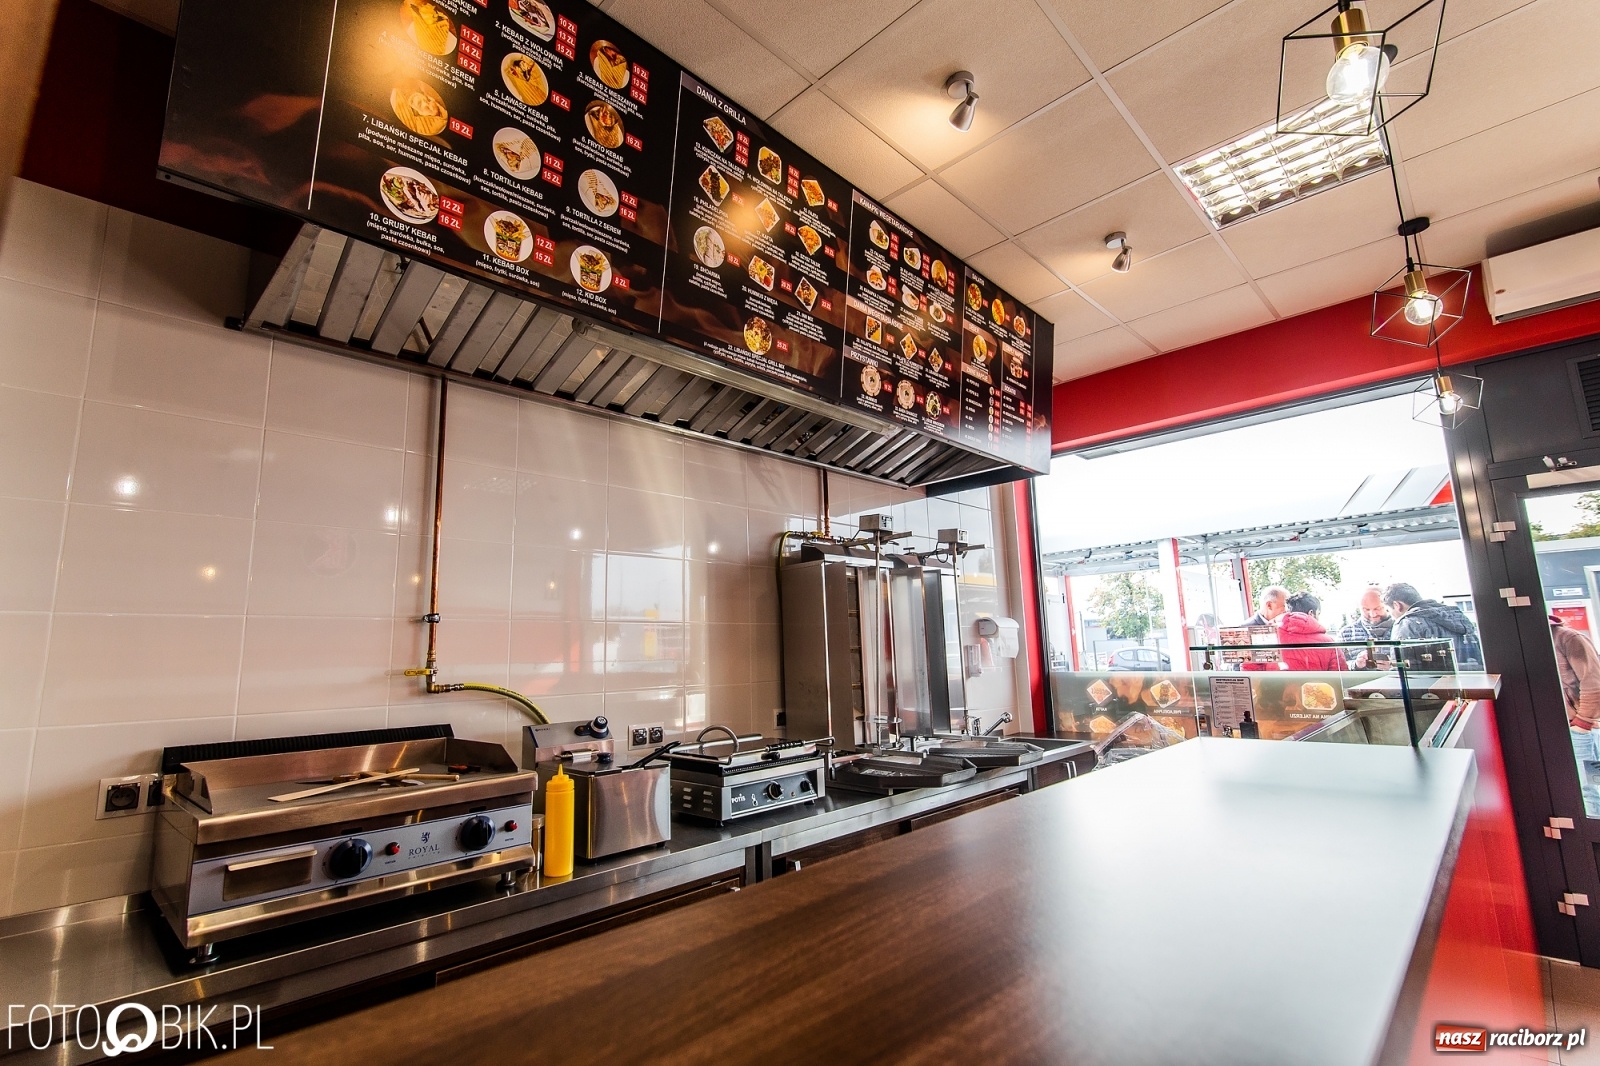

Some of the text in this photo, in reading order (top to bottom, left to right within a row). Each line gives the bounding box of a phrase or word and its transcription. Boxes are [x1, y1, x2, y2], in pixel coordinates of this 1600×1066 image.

[495, 20, 501, 31] 2.
[502, 24, 524, 44] KEBAB
[559, 17, 576, 34] 10 ZŁ
[462, 28, 482, 46] 11 ZŁ
[558, 30, 575, 47] 13 ZŁ
[461, 42, 481, 60] 14 ZŁ
[557, 43, 574, 59] 15 ZŁ
[417, 49, 443, 69] KEBAB
[450, 65, 475, 85] SEREM
[459, 56, 479, 73] 16 ZŁ
[584, 74, 604, 92] KEBAB
[641, 69, 648, 80] ZŁ
[640, 81, 647, 92] ZŁ
[494, 89, 549, 123] 5. LAWASZ KEBAB
[552, 93, 569, 109] 16 ZŁ
[639, 93, 646, 103] ZŁ
[696, 85, 717, 106] DANIA
[724, 103, 746, 126] GRILLA
[451, 120, 472, 137] 19 ZŁ
[362, 114, 468, 167] 7. LIBAŃSKI SPECJAŁ KEBAB
[365, 126, 396, 146] (podwójne
[397, 140, 423, 158] mieszane
[634, 139, 641, 150] ZŁ
[358, 132, 471, 186] pita, sos, ser, hummus, pasta czosnkowa)
[545, 155, 562, 170] 11 ZŁ
[605, 148, 624, 163] KEBAB
[483, 168, 543, 201] 8. TORTILLA KEBAB
[543, 170, 561, 185] 15 ZŁ
[441, 198, 463, 215] 12 ZŁ
[622, 193, 637, 207] 12 ZŁ
[440, 213, 461, 230] 16 ZŁ
[572, 208, 598, 226] TORTILLA
[603, 222, 622, 236] SEREM
[628, 210, 635, 220] ZŁ
[369, 212, 437, 244] 10. GRUBY KEBAB
[381, 232, 397, 245] pasta
[536, 237, 554, 251] 12 ZŁ
[433, 243, 445, 254] sos,
[482, 253, 530, 277] 11. KEBAB BOX
[535, 251, 553, 265] 15 ZŁ
[620, 278, 627, 288] ZŁ
[584, 291, 594, 301] KID
[595, 295, 607, 305] BOX
[409, 843, 440, 856] ROYAL
